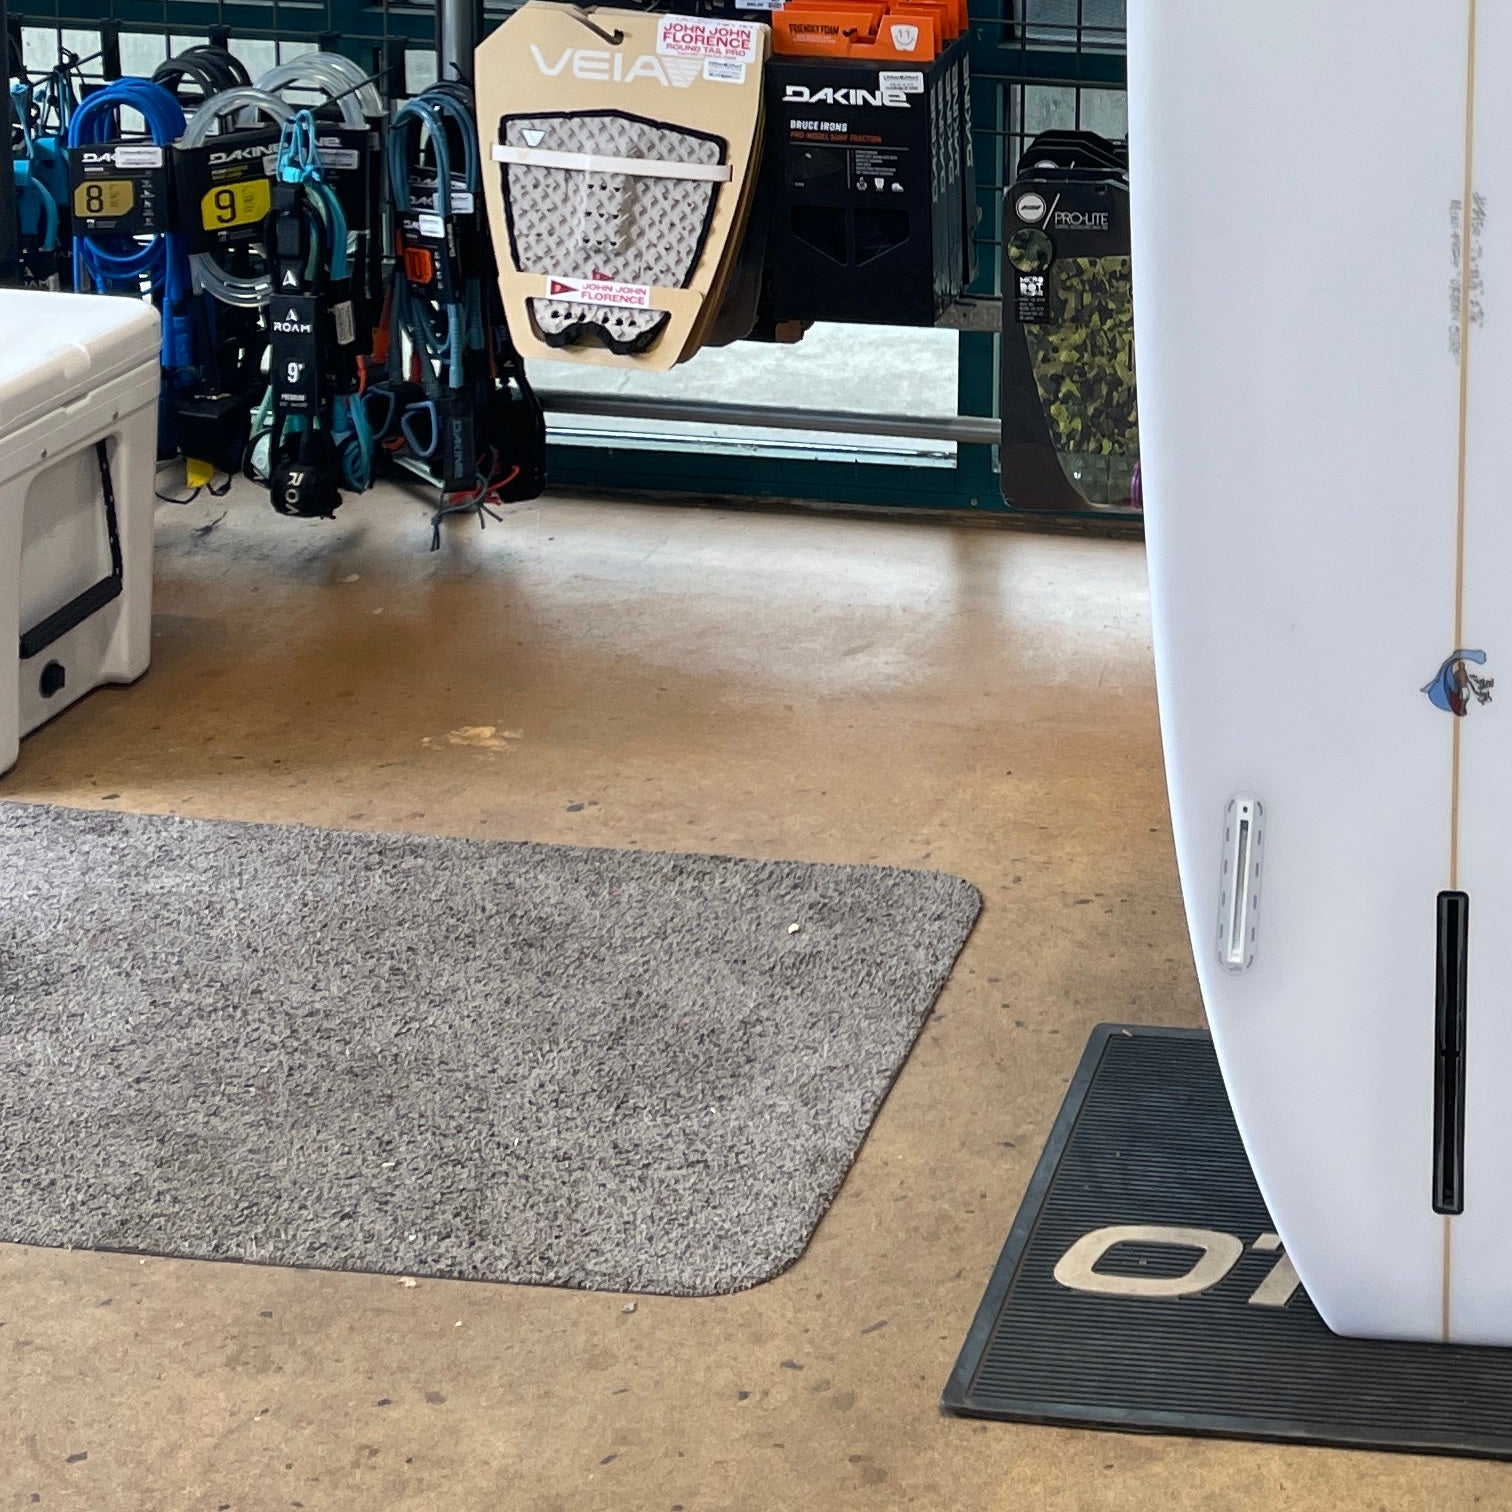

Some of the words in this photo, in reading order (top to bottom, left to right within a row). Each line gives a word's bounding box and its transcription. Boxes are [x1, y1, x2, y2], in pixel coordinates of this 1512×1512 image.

[663, 22, 706, 35] JOHN
[709, 26, 751, 39] JOHN
[662, 31, 751, 50] FLORENCE
[666, 42, 701, 53] ROUND
[725, 48, 746, 57] PRO
[529, 43, 670, 87] VEIA
[782, 84, 912, 108] DAKINE
[790, 119, 819, 131] BRUCE
[820, 121, 848, 133] IRONS
[86, 184, 104, 214] 8
[213, 188, 237, 224] 9
[581, 291, 645, 305] FLORENCE
[582, 283, 613, 292] JOHN
[616, 287, 647, 296] JOHN
[273, 321, 312, 333] ROAM
